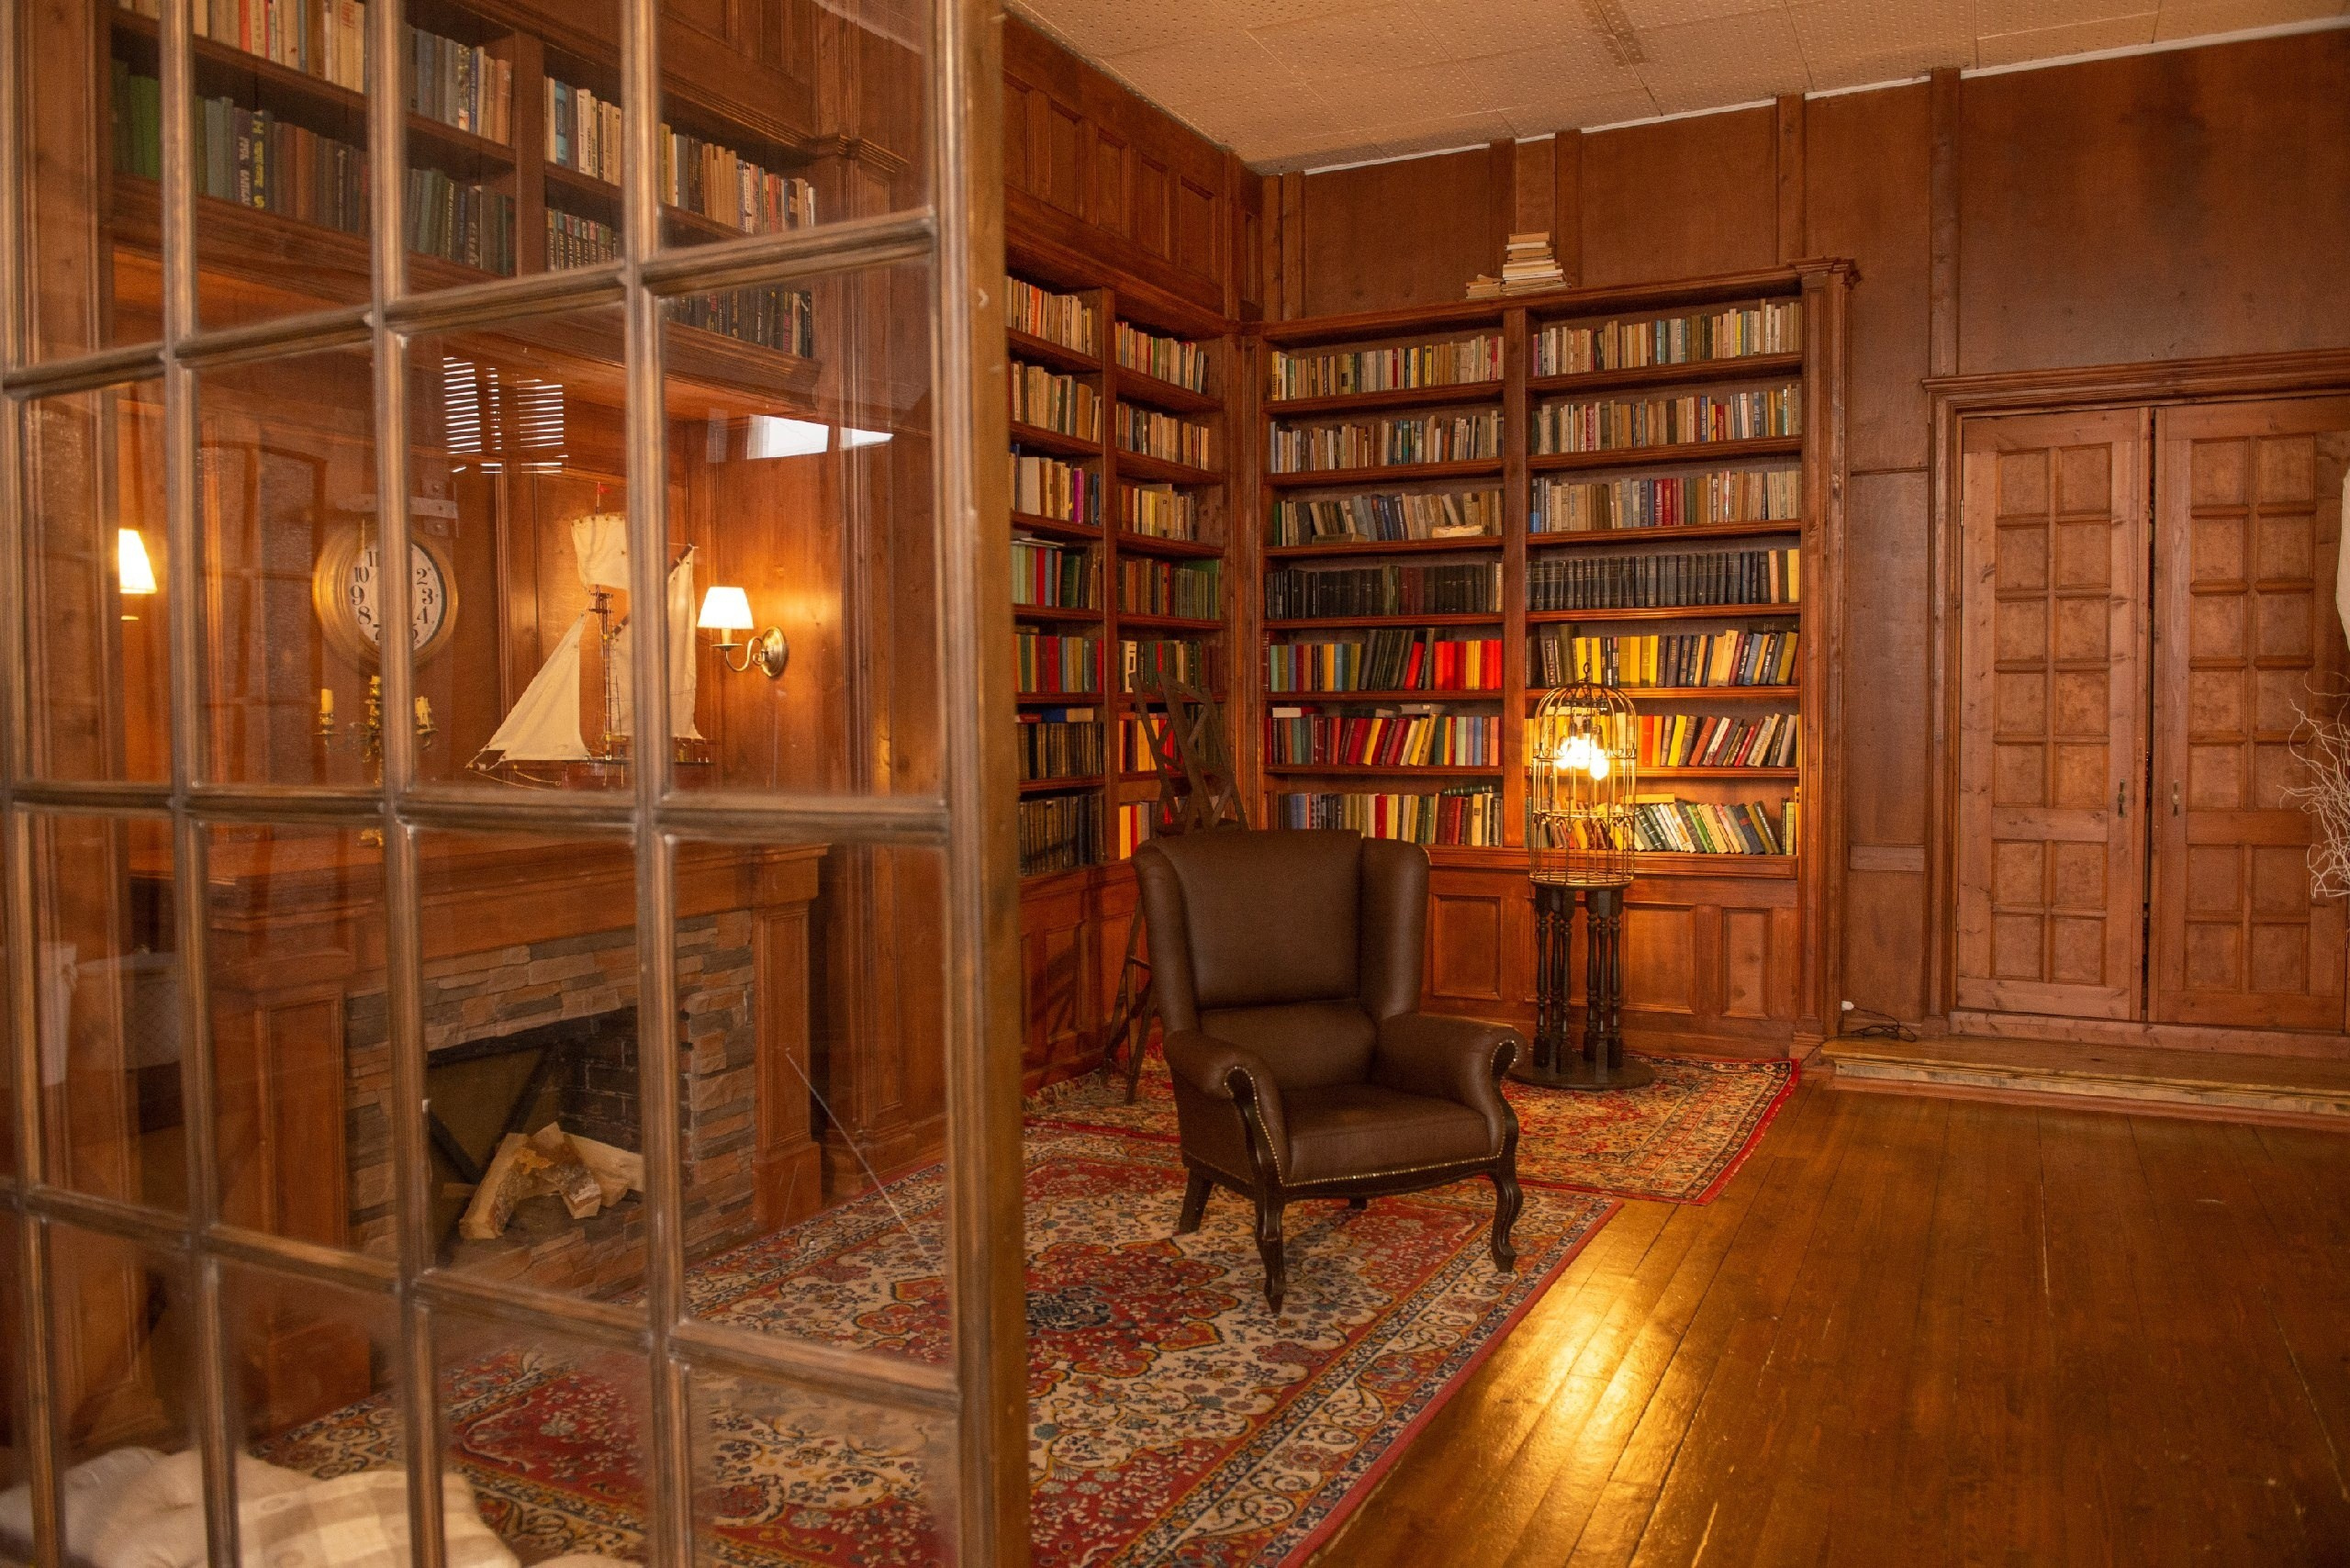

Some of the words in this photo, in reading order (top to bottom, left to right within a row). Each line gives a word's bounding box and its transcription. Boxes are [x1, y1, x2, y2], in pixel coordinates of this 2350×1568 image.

[353, 566, 370, 583] 10
[416, 568, 428, 585] 2
[350, 585, 365, 605] 9
[421, 588, 433, 605] 3
[358, 606, 371, 625] 8
[416, 606, 428, 624] 4
